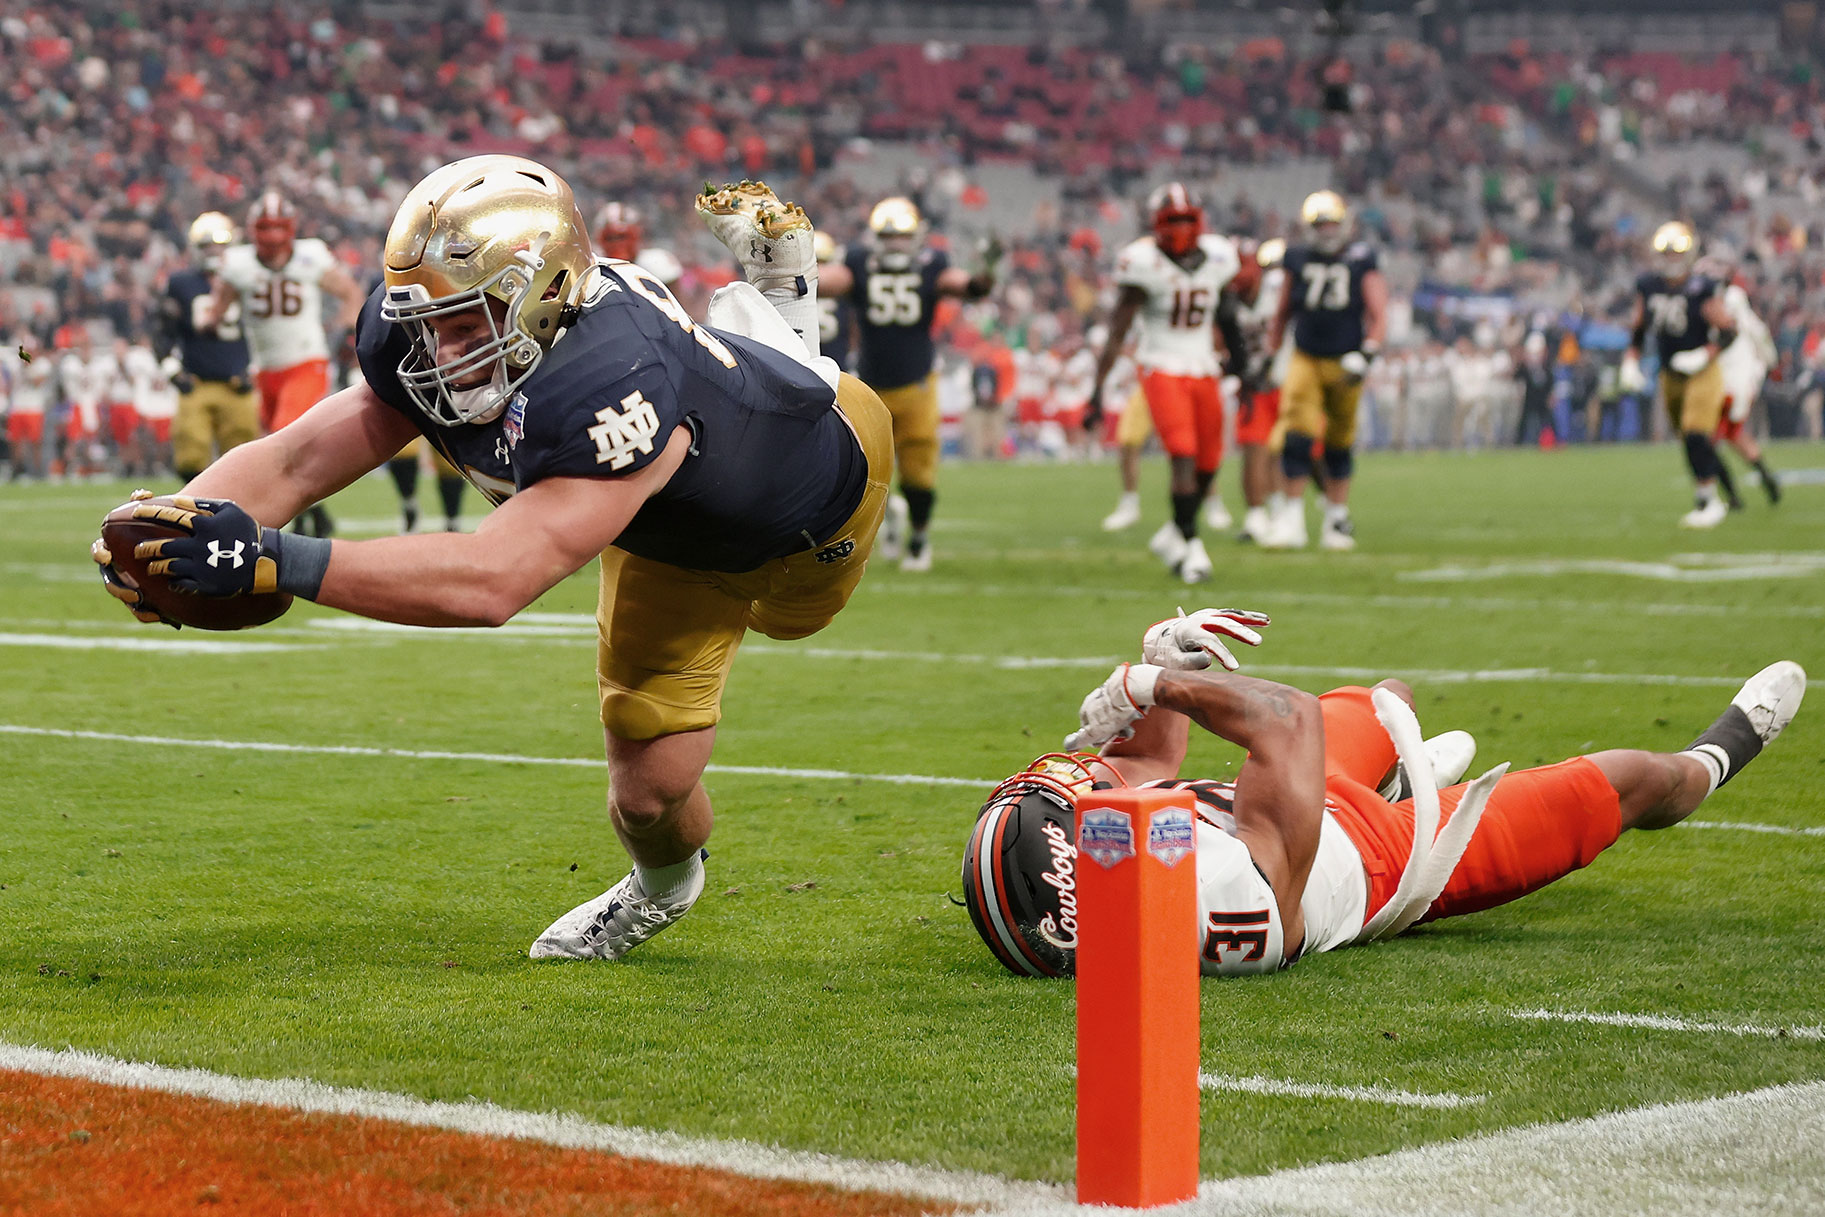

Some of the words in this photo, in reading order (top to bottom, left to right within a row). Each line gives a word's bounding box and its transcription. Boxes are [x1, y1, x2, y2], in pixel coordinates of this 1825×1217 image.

[867, 272, 922, 326] 55
[1170, 288, 1209, 328] 16
[1302, 262, 1351, 311] 73
[1040, 820, 1079, 949] Cowboys
[1202, 909, 1270, 964] 31
